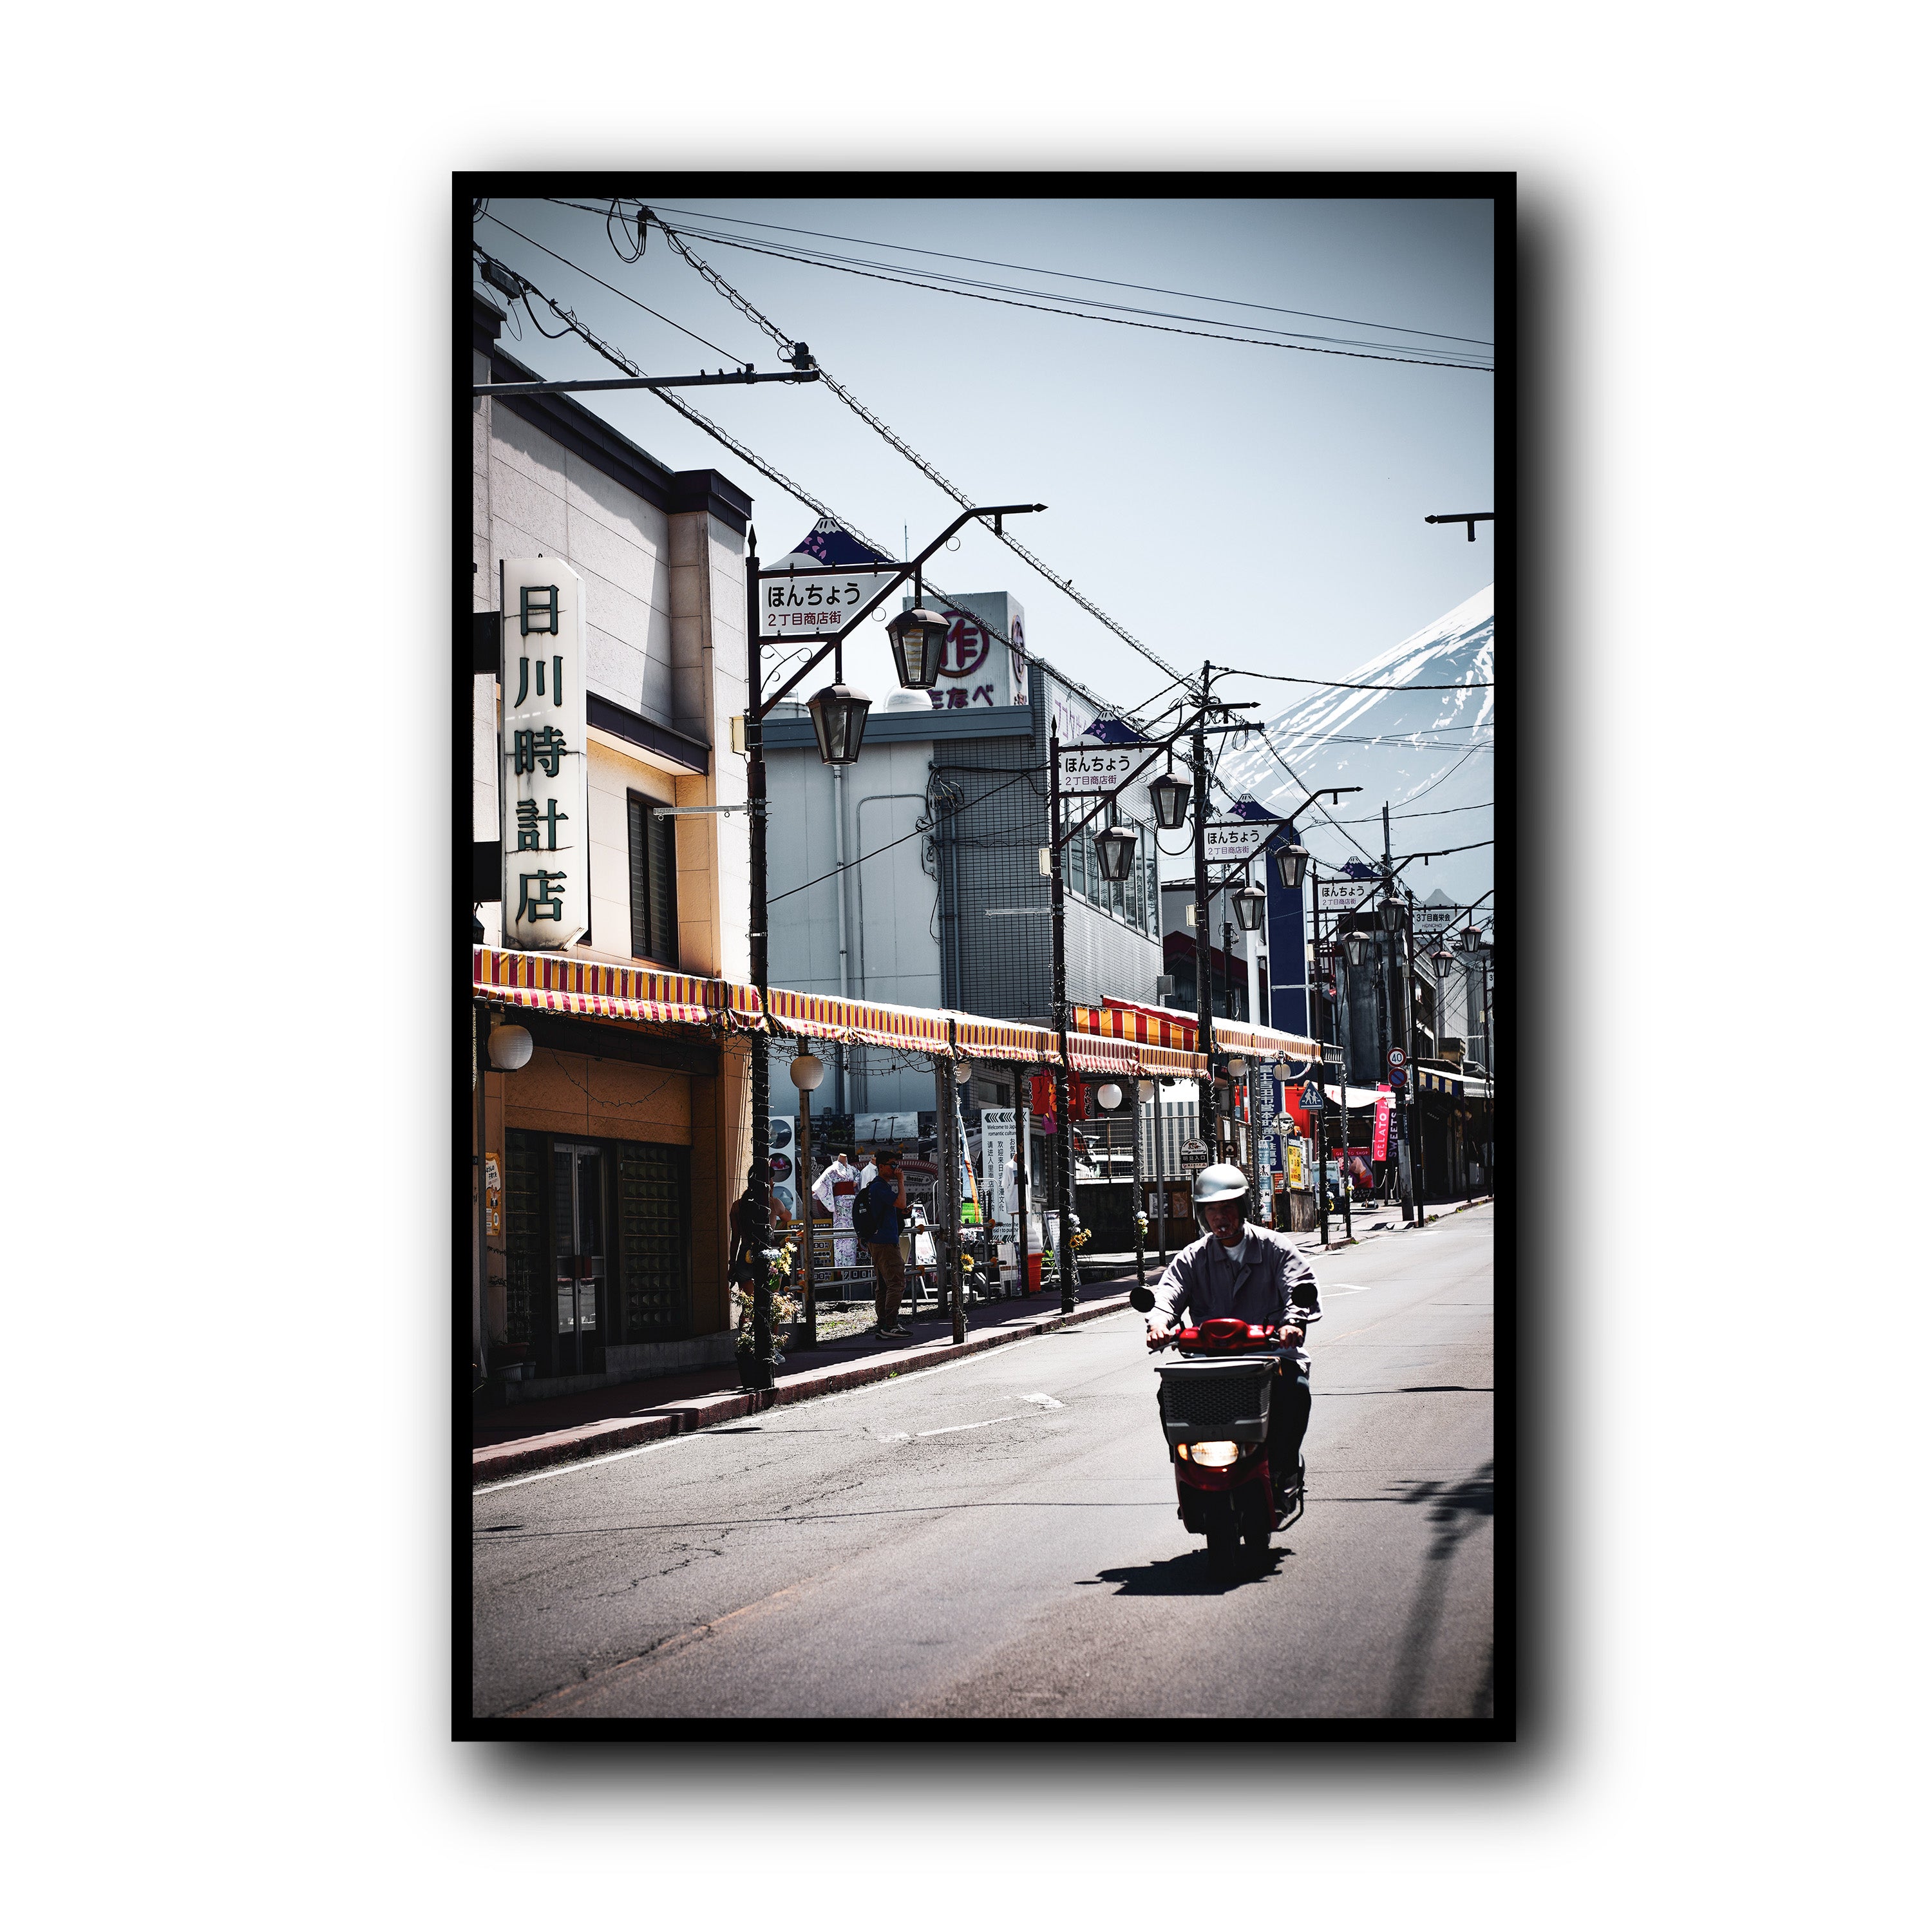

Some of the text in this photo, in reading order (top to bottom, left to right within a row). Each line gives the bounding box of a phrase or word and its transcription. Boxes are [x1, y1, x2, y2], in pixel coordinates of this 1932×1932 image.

[768, 582, 860, 607] ほんちょう
[768, 611, 842, 626] 2丁目商店街
[514, 584, 568, 923] 日川時計店
[1065, 755, 1130, 772] ほんちょう
[1065, 775, 1117, 786] 2丁目商店街
[1208, 829, 1260, 844] ほんちょう
[1208, 846, 1249, 855] 2丁目商店街
[1322, 886, 1365, 897] ほんちょう
[1392, 1053, 1402, 1062] 40
[1377, 1113, 1387, 1157] GELATO
[1388, 1112, 1398, 1157] SWEETS
